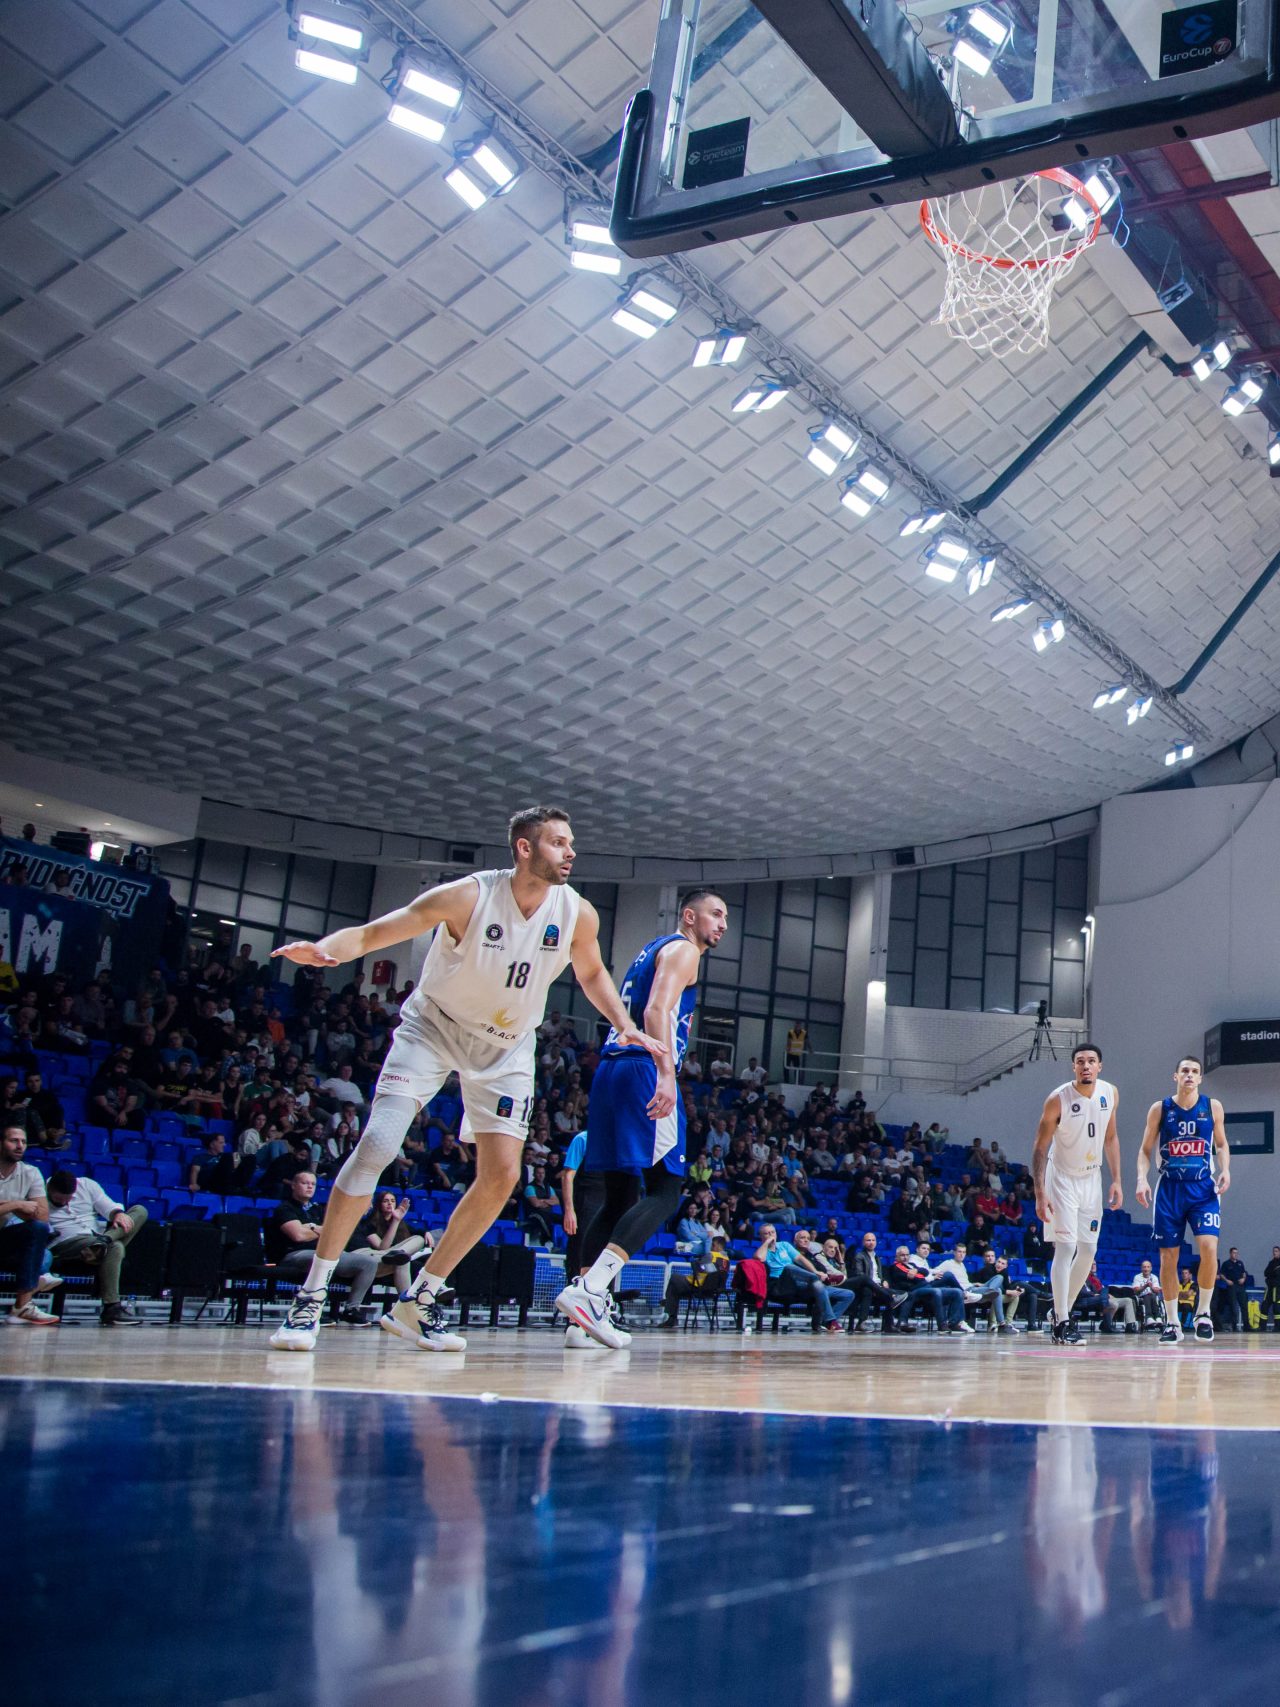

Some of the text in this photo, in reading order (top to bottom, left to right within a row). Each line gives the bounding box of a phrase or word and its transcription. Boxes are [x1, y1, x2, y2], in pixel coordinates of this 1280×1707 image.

[1162, 46, 1213, 64] EuroCup
[505, 960, 531, 988] 18
[1240, 1030, 1280, 1042] stadion
[1087, 1122, 1096, 1138] 0
[1177, 1120, 1196, 1136] 30
[1170, 1142, 1202, 1155] VOLI
[1203, 1212, 1220, 1229] 30
